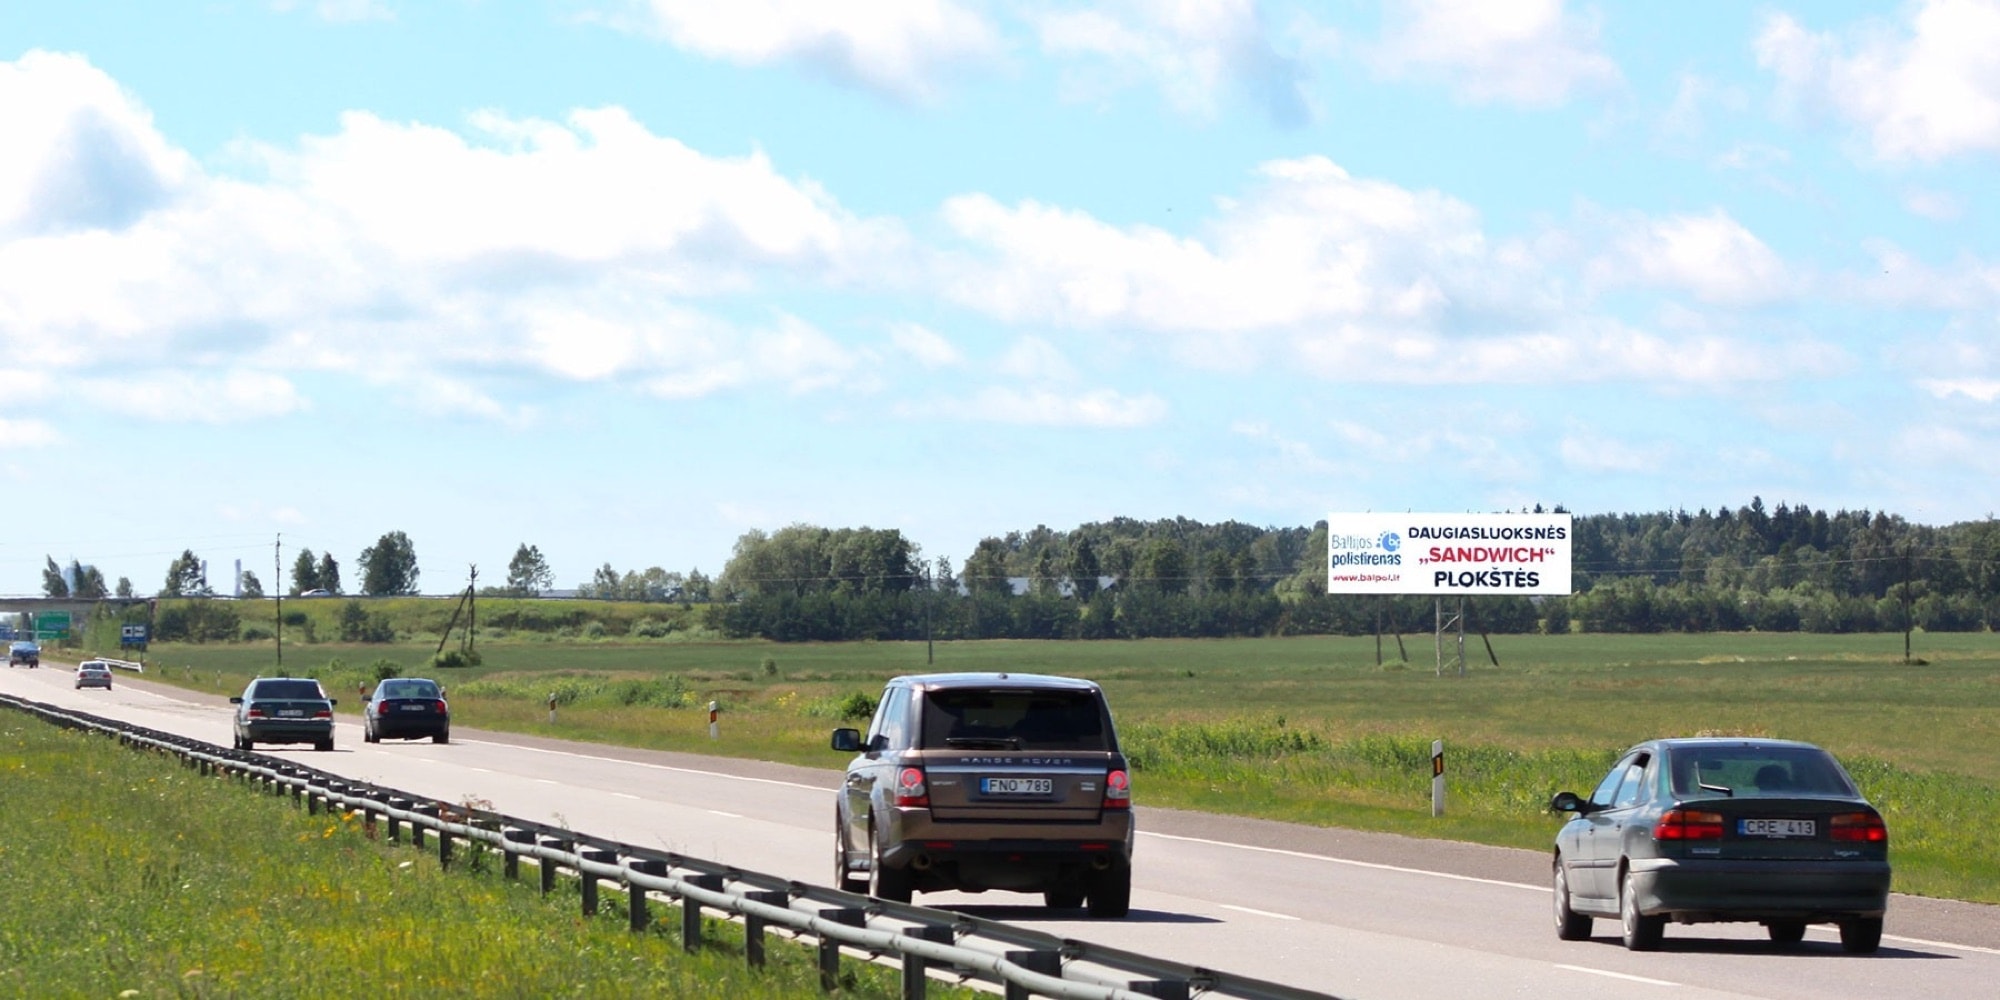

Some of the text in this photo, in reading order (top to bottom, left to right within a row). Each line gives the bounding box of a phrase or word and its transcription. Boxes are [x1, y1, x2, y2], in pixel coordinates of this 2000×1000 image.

[1408, 525, 1566, 540] DAUGIASLUOKSNĖS
[1331, 534, 1373, 550] Baltijos
[1332, 551, 1401, 568] polistirenas
[1434, 566, 1540, 588] PLOKŠTĖS
[989, 780, 1050, 791] FNO 789
[1746, 820, 1813, 834] CRE 413
